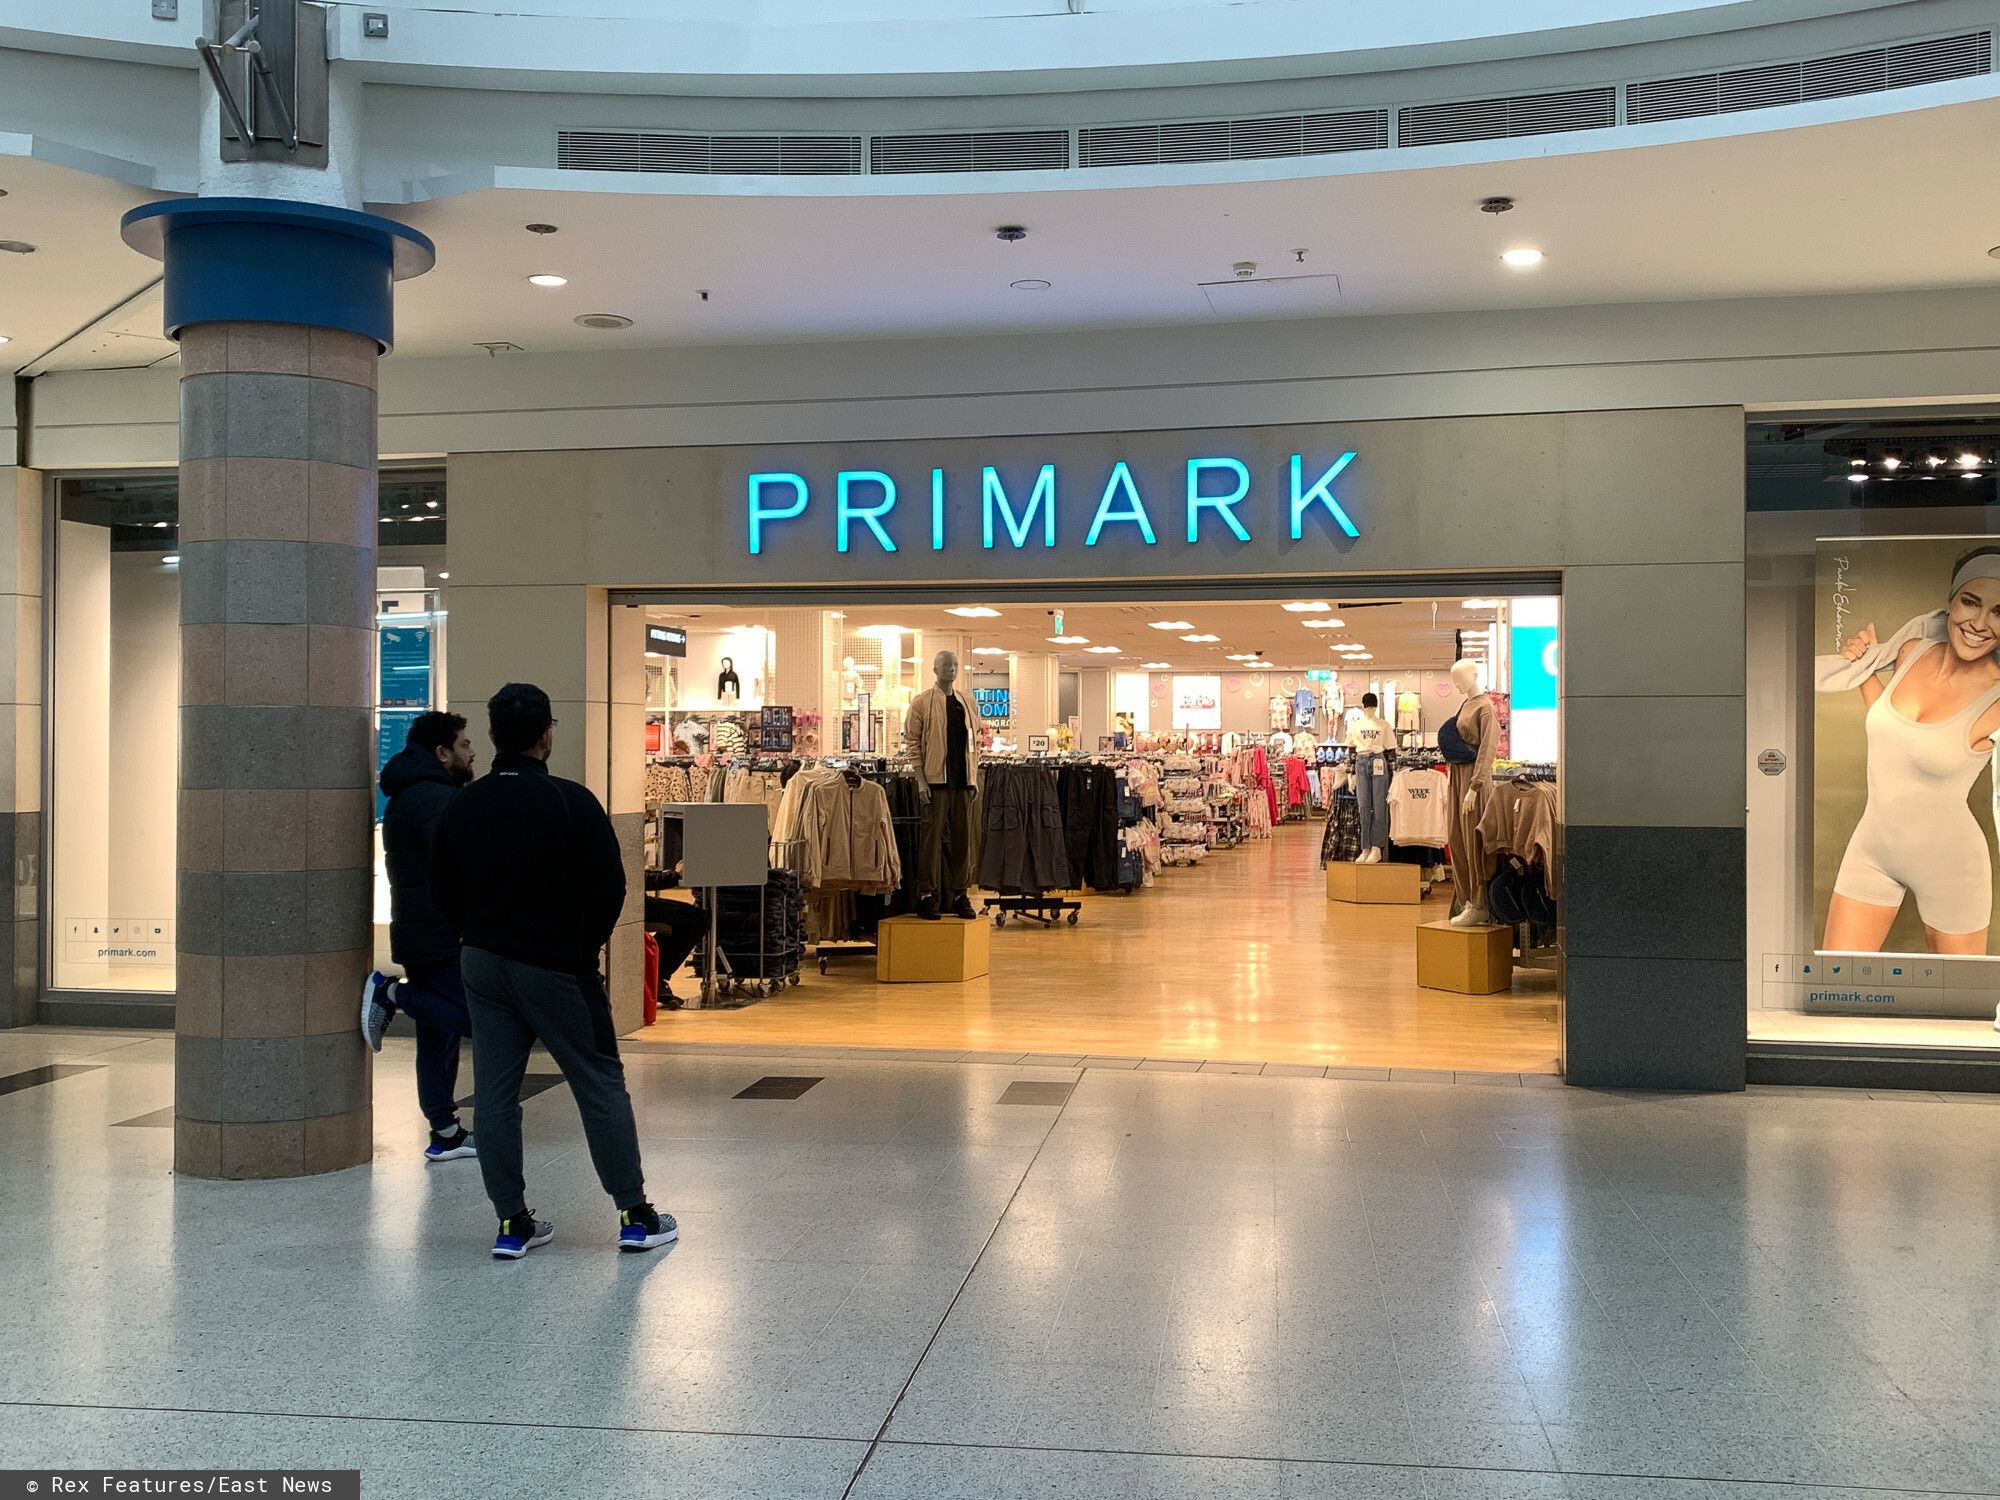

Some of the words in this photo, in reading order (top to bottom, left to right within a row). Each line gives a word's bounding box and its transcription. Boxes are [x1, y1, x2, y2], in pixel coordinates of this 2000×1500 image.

[748, 450, 1361, 555] PRIMARK
[98, 947, 157, 958] primark.com
[1810, 991, 1895, 1004] primark.com
